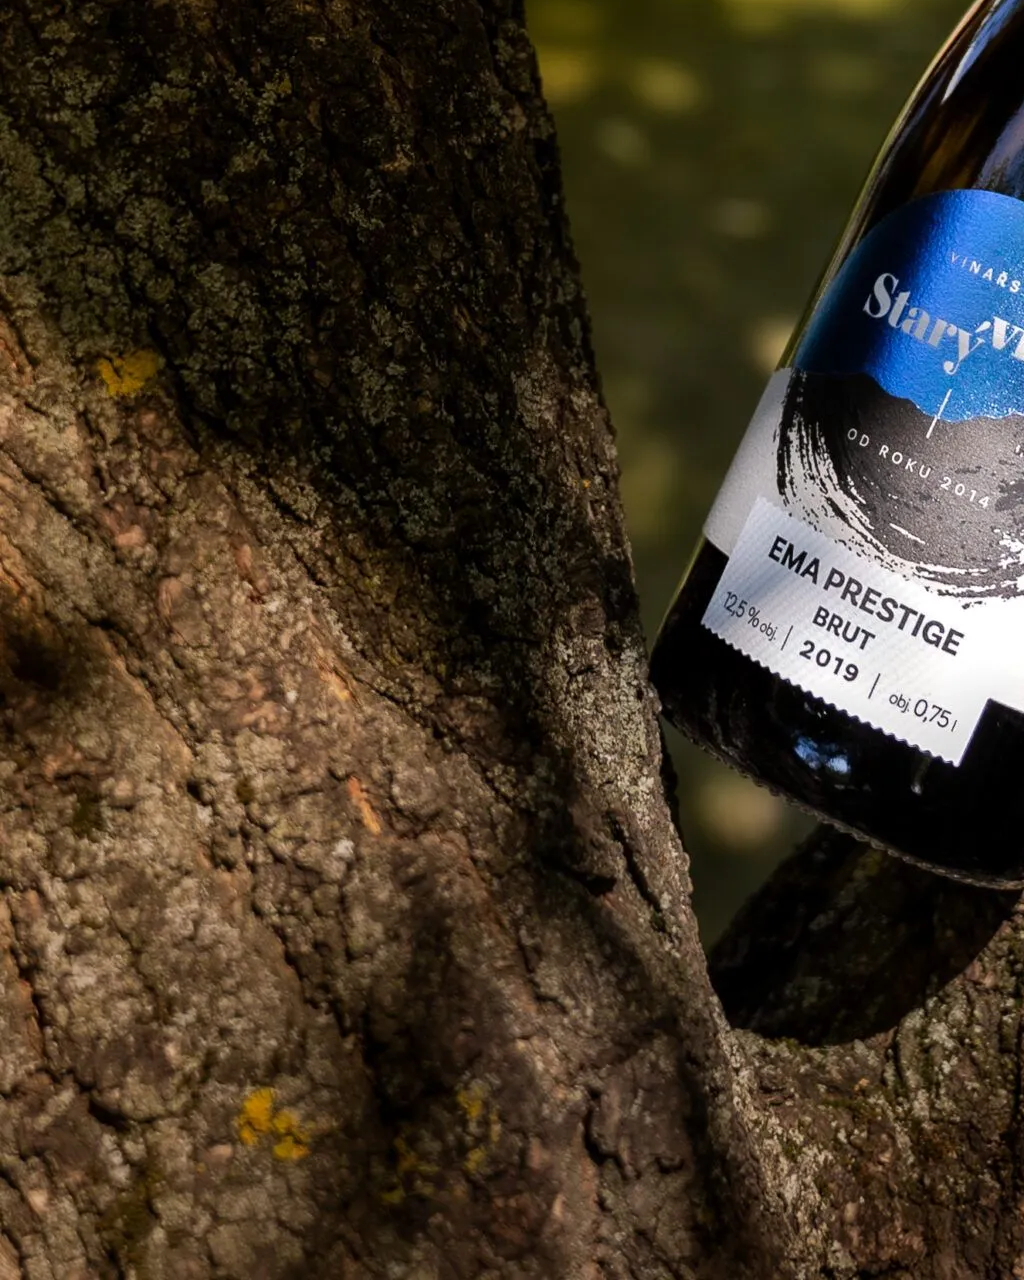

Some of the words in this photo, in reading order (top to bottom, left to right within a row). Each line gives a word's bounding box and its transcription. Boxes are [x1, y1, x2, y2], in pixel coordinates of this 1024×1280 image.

[862, 271, 992, 375] Starý
[847, 427, 870, 448] OD
[878, 444, 933, 479] ROKU
[940, 476, 991, 510] 2014
[723, 590, 748, 620] 12,5
[748, 605, 762, 628] %
[768, 535, 821, 585] EMA
[823, 567, 966, 657] PRESTIGE
[811, 605, 876, 651] BRUT
[799, 639, 860, 683] 2019
[888, 691, 912, 714] obj.
[913, 698, 952, 729] 0,75
